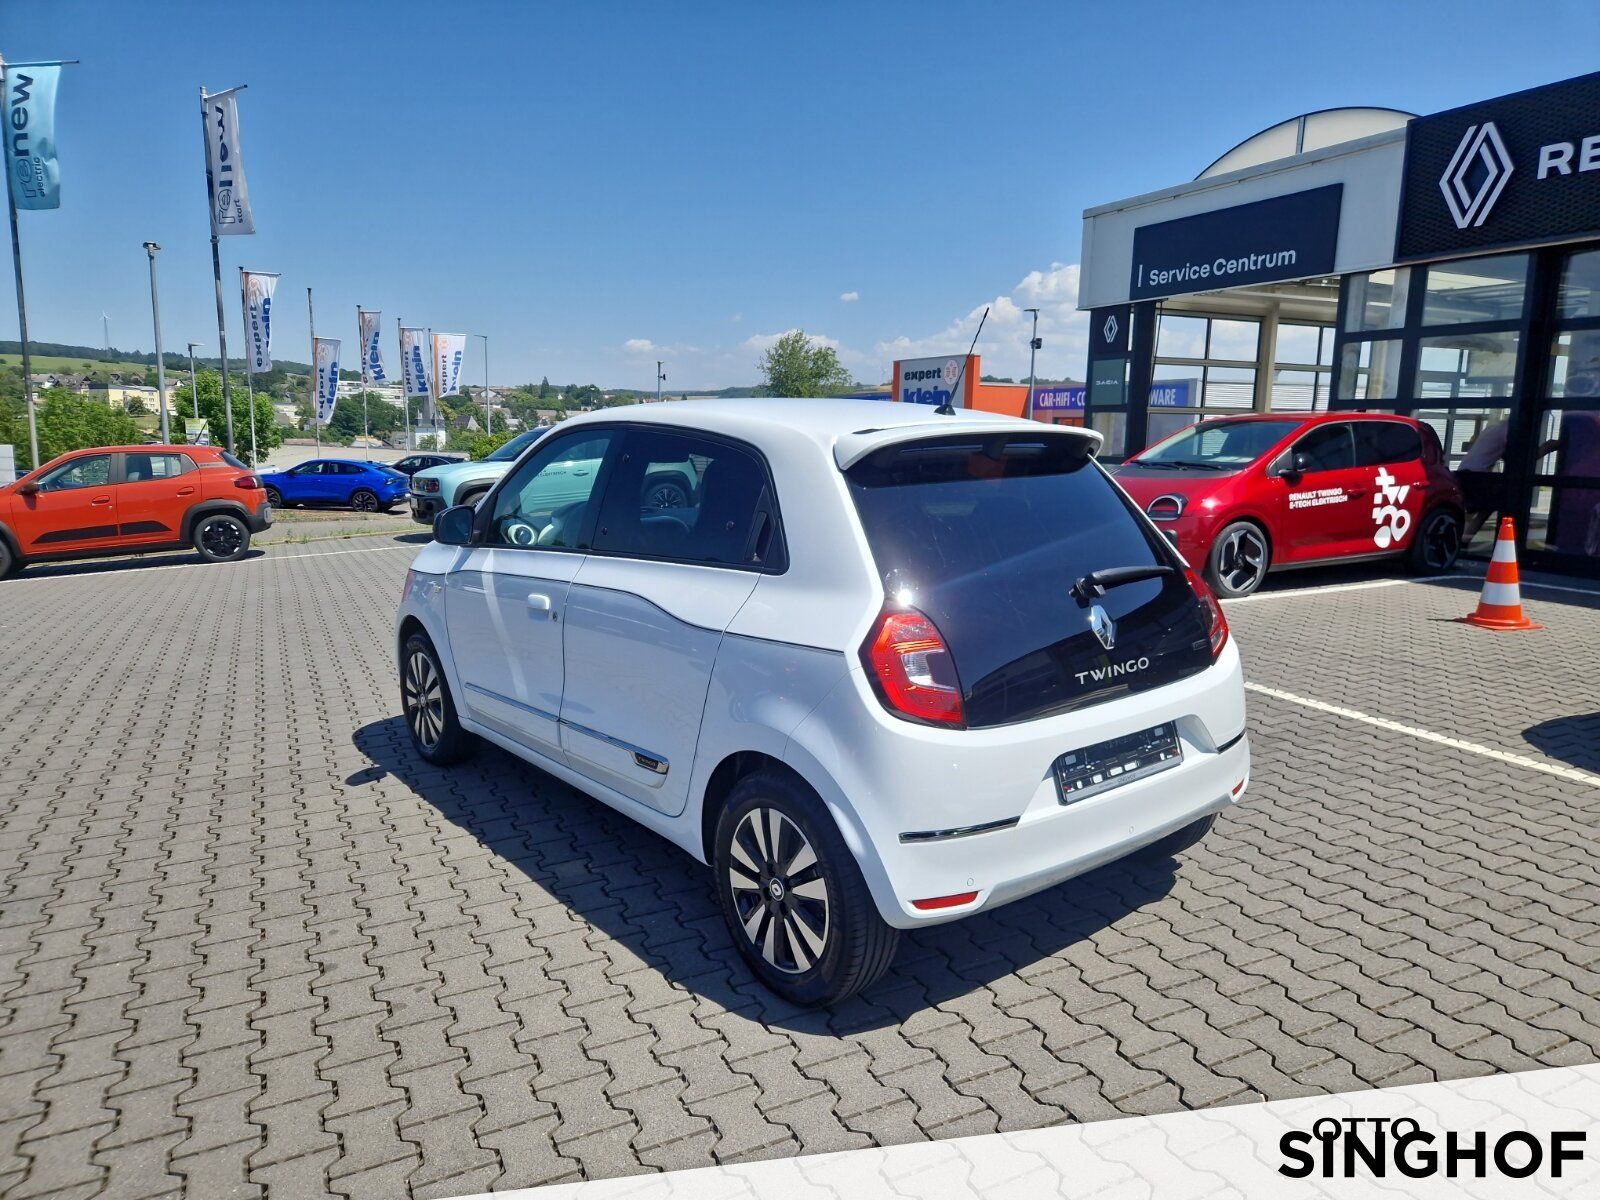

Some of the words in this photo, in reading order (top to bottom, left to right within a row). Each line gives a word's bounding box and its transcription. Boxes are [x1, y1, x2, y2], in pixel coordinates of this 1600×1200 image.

[11, 73, 37, 198] renew
[1149, 263, 1210, 286] Service
[1213, 250, 1296, 276] Centrum
[250, 304, 262, 368] expert
[369, 331, 386, 381] klein
[404, 350, 413, 394] expert
[412, 345, 428, 393] klein
[904, 367, 941, 382] expert
[903, 385, 951, 406] klein
[1039, 391, 1070, 407] CAR-HIFI
[1289, 491, 1317, 501] RENAULT
[1317, 488, 1343, 498] TWINGO
[1312, 495, 1348, 506] ELEKTRISCH
[1075, 657, 1149, 685] TWINGO
